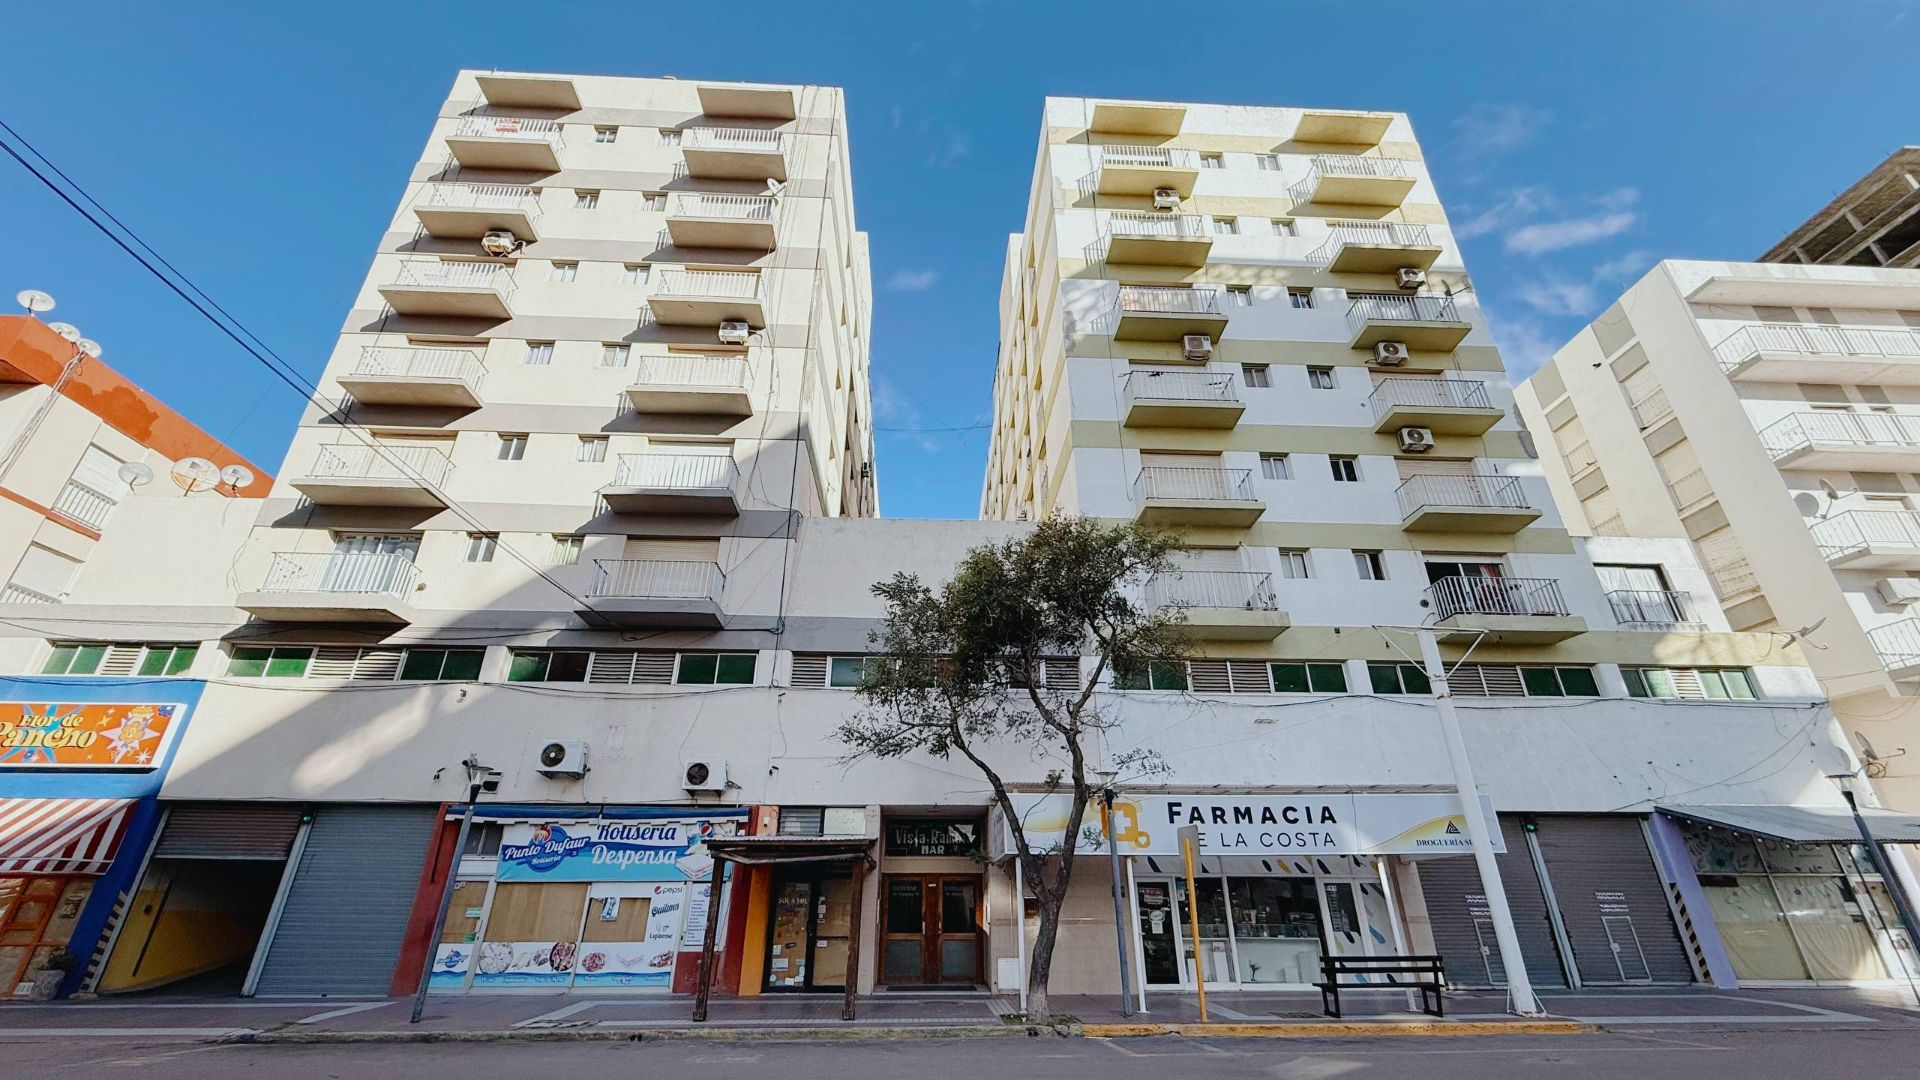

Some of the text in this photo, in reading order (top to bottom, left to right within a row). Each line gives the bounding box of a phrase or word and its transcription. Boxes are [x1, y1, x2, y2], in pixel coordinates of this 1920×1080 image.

[16, 713, 84, 728] Flor de
[1220, 832, 1248, 848] LA
[1259, 832, 1336, 848] COSTA
[504, 837, 590, 860] Punto Dufaur
[921, 845, 945, 855] MAR
[591, 844, 677, 870] Despensa
[662, 887, 683, 895] pepsi
